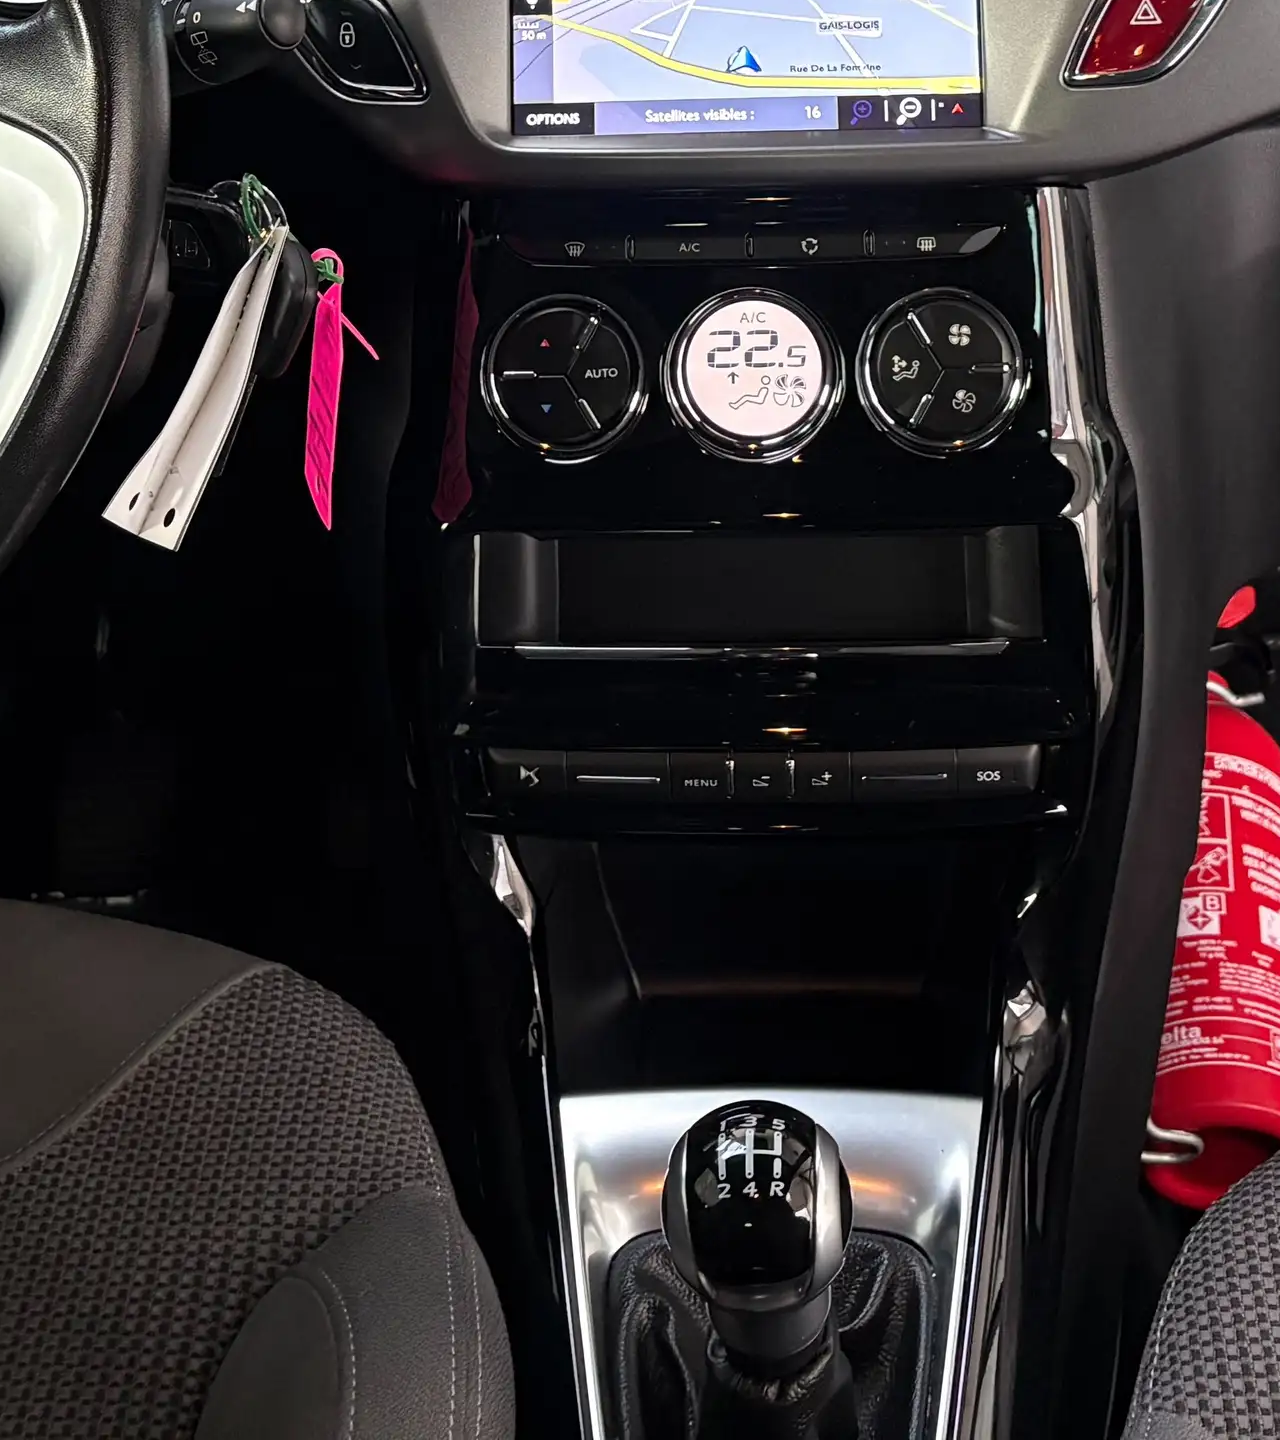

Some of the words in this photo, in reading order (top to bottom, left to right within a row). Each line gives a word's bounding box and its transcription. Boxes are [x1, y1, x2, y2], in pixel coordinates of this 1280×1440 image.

[192, 11, 201, 24] 0
[819, 20, 880, 31] GAIS-LOGIS
[521, 31, 536, 40] 50
[790, 65, 808, 73] Rue
[827, 64, 838, 72] La
[526, 112, 580, 126] OPTIONS
[645, 108, 700, 124] Satellites
[703, 107, 747, 122] visibles
[804, 106, 822, 120] 16
[678, 241, 701, 253] A/C
[740, 311, 767, 325] A/C
[706, 329, 807, 369] 22.5
[584, 366, 619, 380] AUTO
[683, 778, 718, 788] MENU
[976, 769, 1001, 783] SOS
[1205, 895, 1220, 912] B
[1161, 1025, 1202, 1045] elta
[719, 1120, 726, 1132] 1
[741, 1116, 758, 1127] 3
[772, 1118, 786, 1131] 5
[717, 1183, 732, 1199] 2
[742, 1181, 758, 1198] 4
[770, 1181, 785, 1197] R
